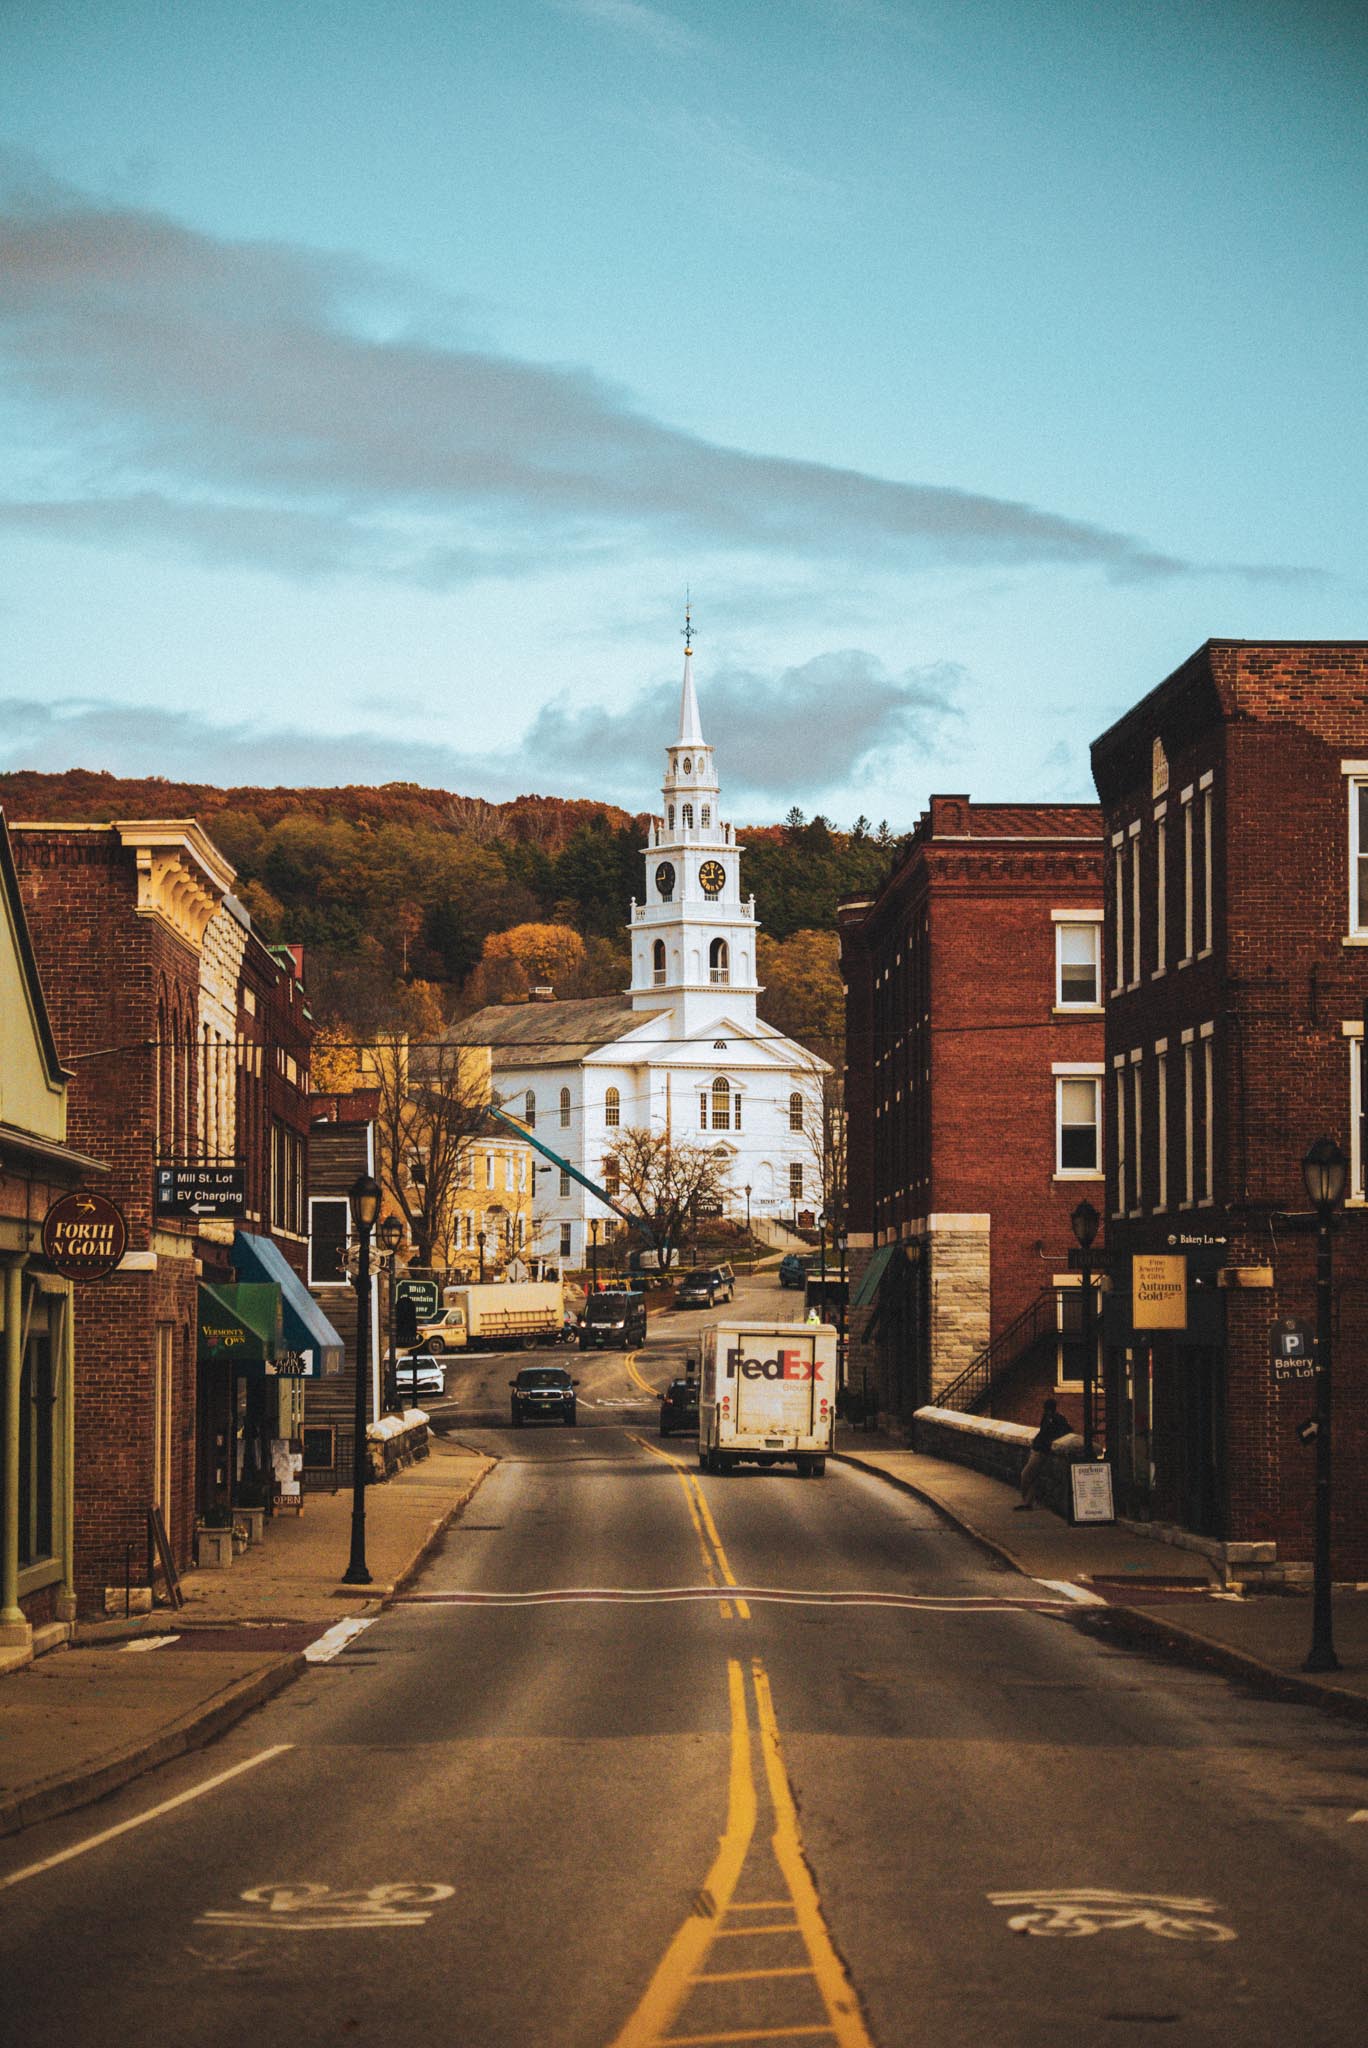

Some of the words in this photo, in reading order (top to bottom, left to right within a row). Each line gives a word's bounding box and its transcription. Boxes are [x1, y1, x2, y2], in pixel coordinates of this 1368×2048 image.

[177, 1173, 196, 1183] Mill
[198, 1173, 213, 1183] St.
[216, 1173, 233, 1184] Lot
[177, 1191, 192, 1200] EV
[194, 1191, 243, 1203] Charging
[55, 1222, 115, 1239] FORTH
[1180, 1234, 1202, 1246] Bakery
[1204, 1234, 1214, 1244] Ln
[68, 1239, 116, 1256] GOAL
[1140, 1281, 1182, 1292] Autumn
[1138, 1291, 1163, 1301] Gold
[1286, 1336, 1300, 1353] P
[727, 1348, 824, 1381] FedEx
[1275, 1358, 1313, 1369] Bakery
[1276, 1370, 1293, 1380] Ln.
[1296, 1368, 1314, 1378] Lot
[273, 1495, 301, 1505] OPEN
